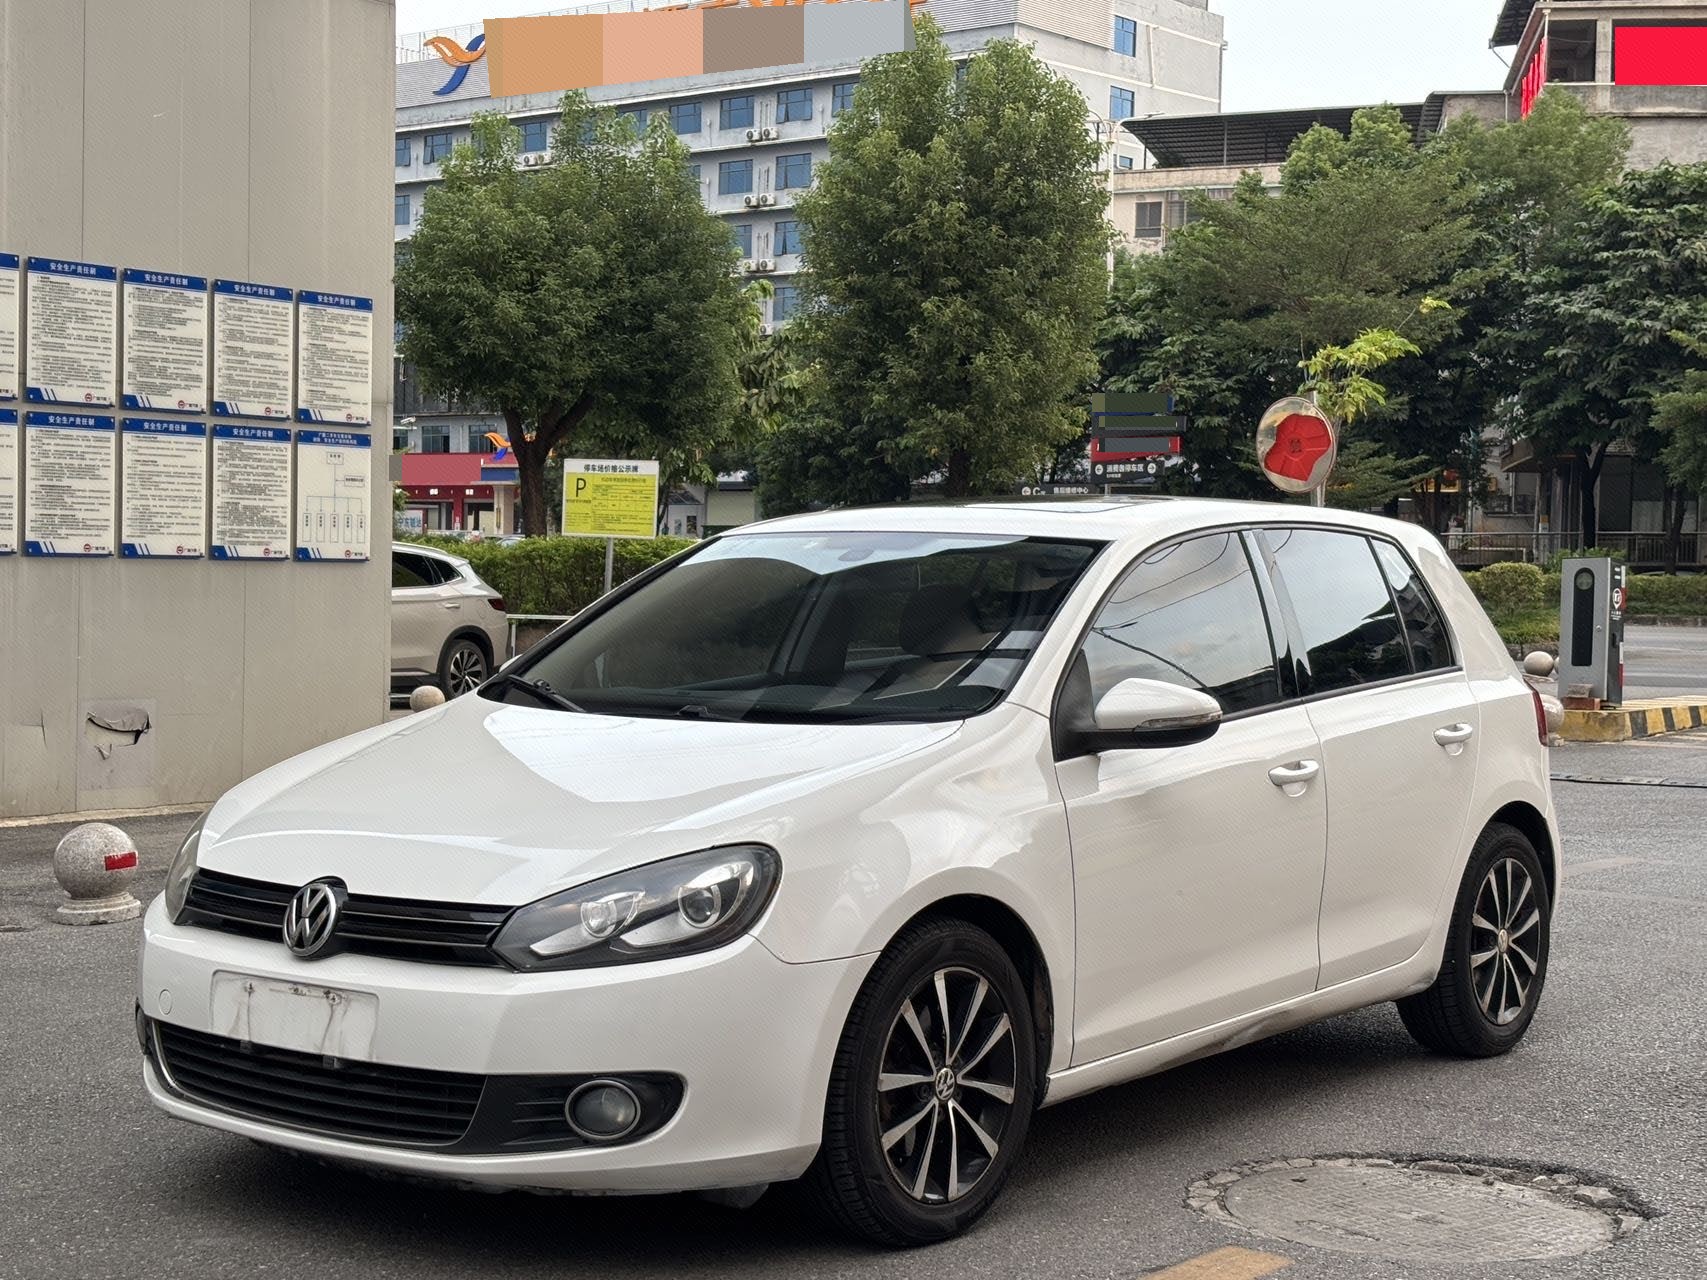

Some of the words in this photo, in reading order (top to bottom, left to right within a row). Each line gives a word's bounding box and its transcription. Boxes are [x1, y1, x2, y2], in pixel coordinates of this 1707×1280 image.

[49, 262, 97, 276] 安全生产责任制
[144, 273, 189, 286] 安全生产责任制
[233, 284, 276, 297] 安全生产责任制
[317, 294, 356, 306] 安全生产责任制
[48, 415, 95, 426] 安全生产责任制
[143, 421, 187, 432] 安全生产责任制
[232, 427, 274, 438] 安全生产责任制
[575, 477, 587, 498] P
